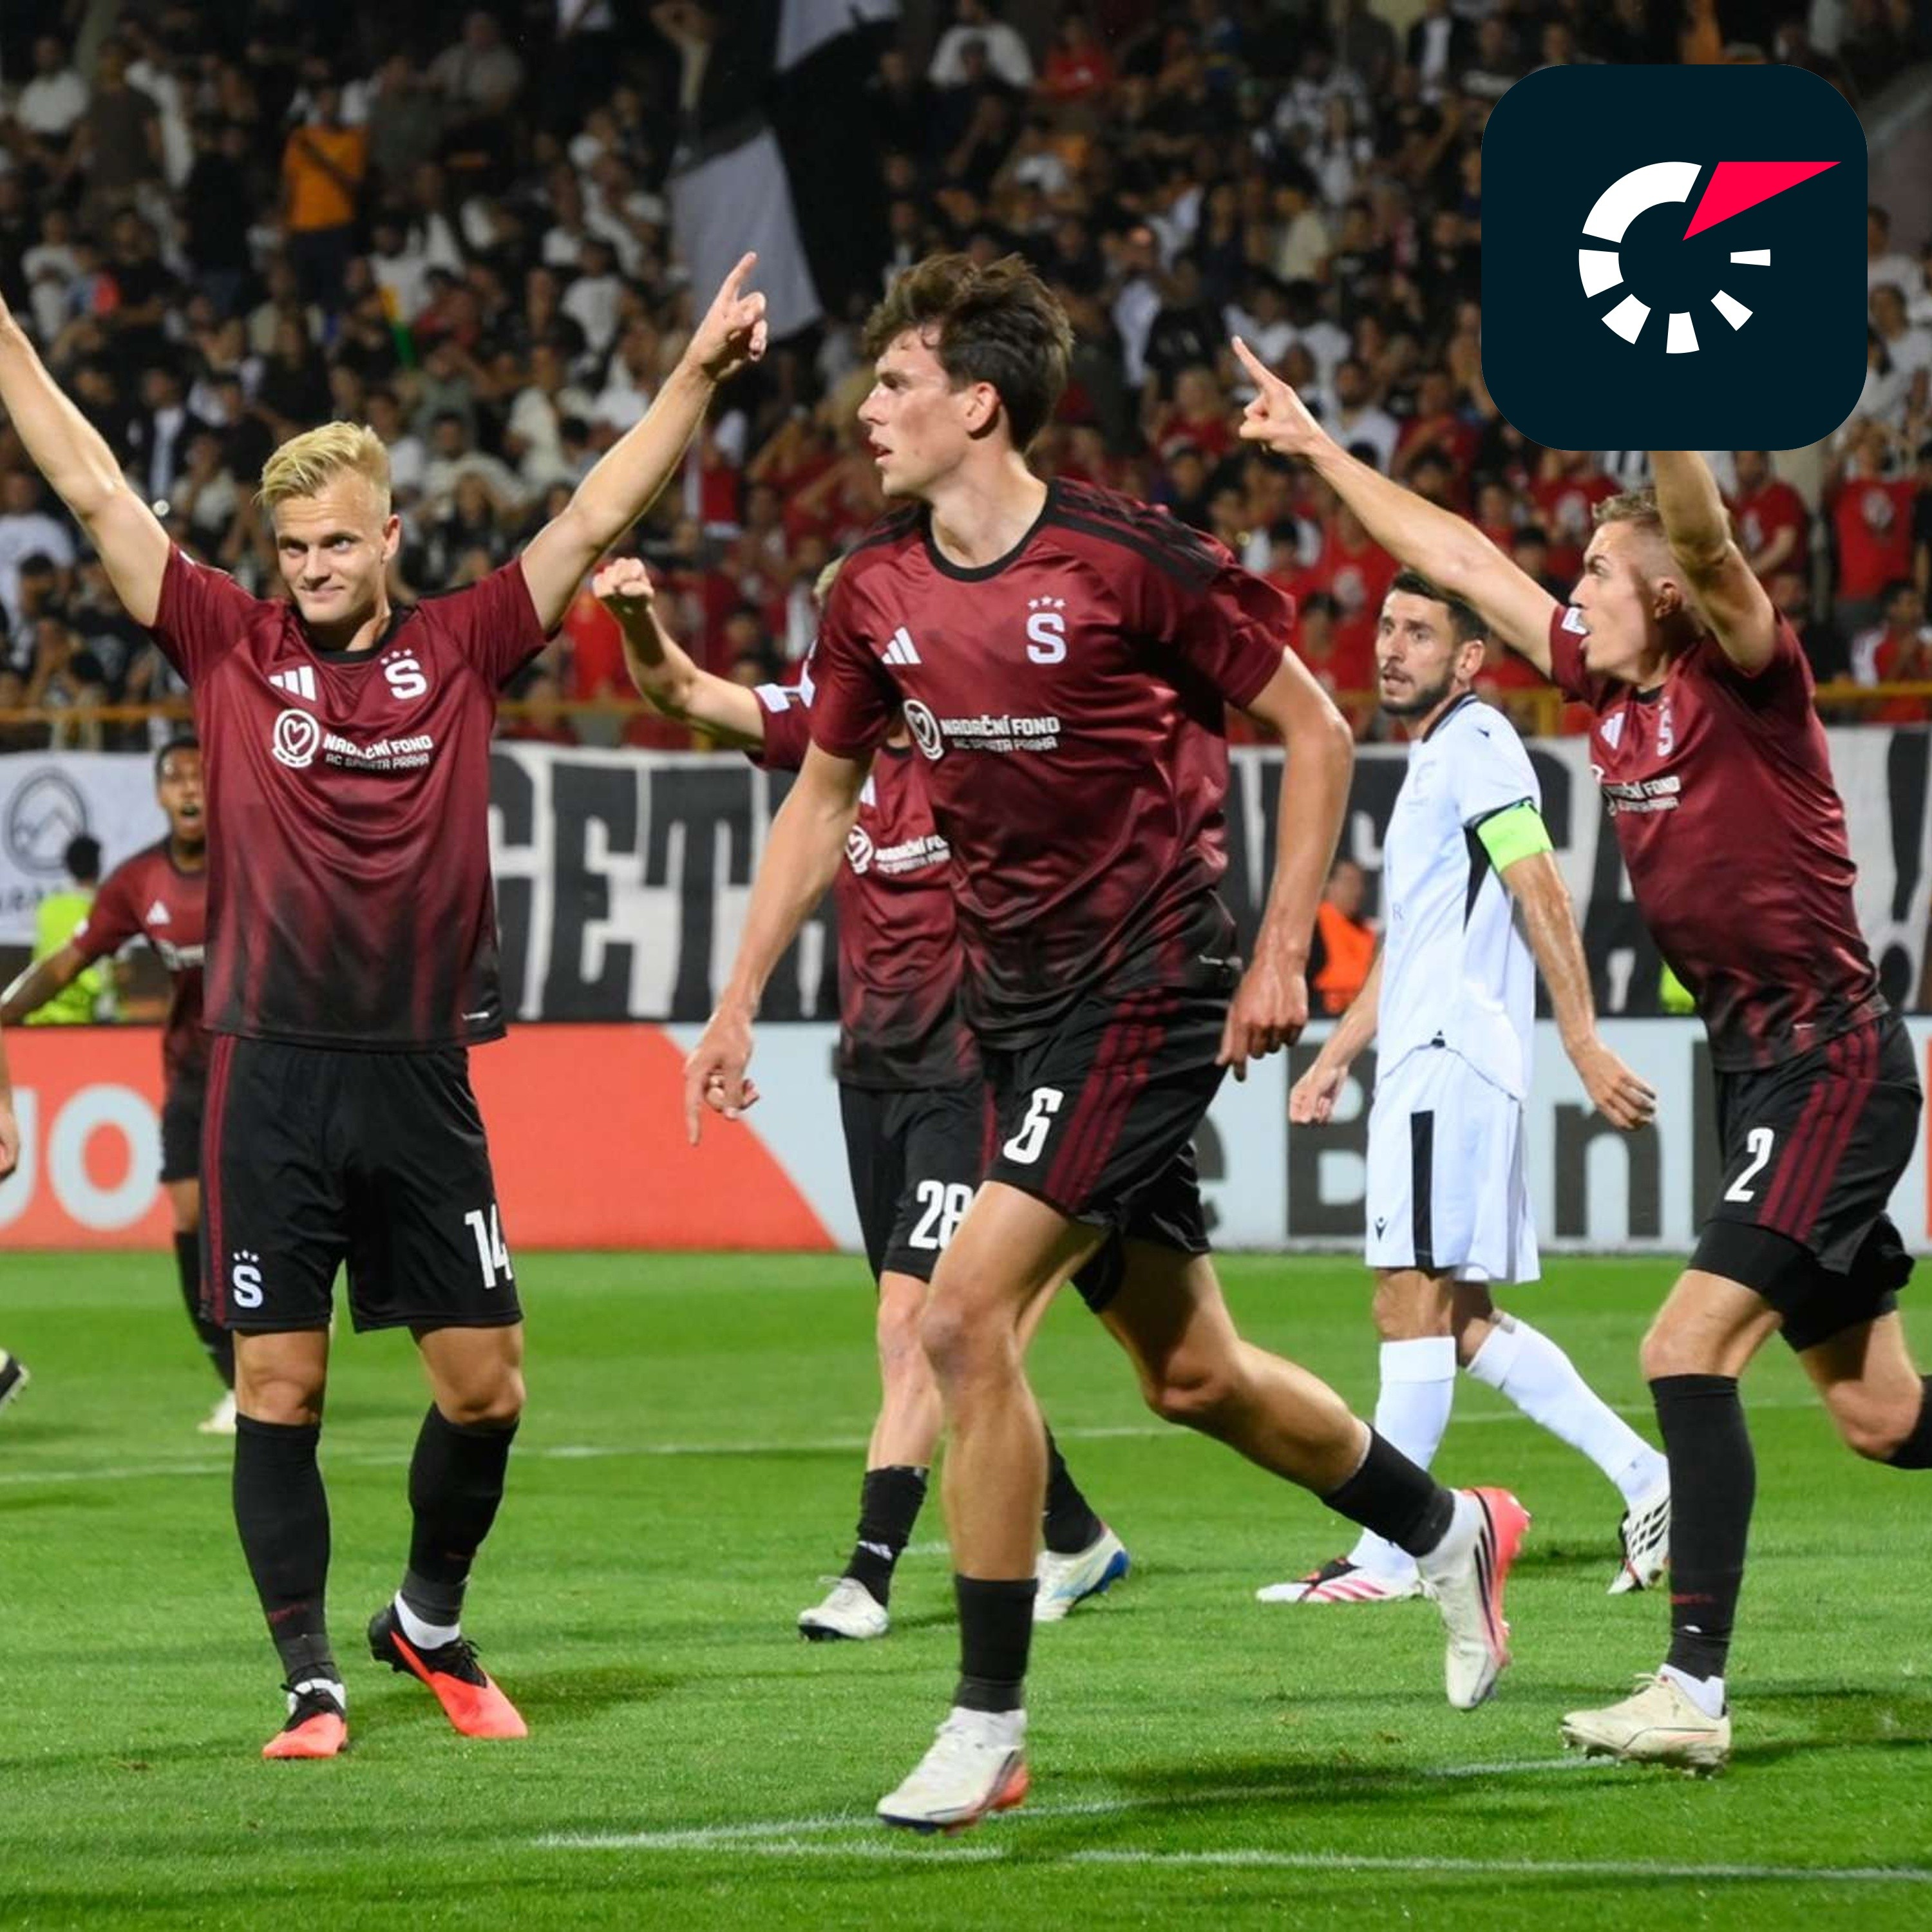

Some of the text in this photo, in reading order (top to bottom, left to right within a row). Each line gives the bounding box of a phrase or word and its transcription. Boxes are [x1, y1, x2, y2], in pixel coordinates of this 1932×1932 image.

[390, 735, 433, 754] FOND
[1011, 717, 1060, 735] FOND
[1003, 1086, 1064, 1164] 6
[1723, 1127, 1775, 1202] 2
[464, 1203, 513, 1289] 14
[908, 1180, 974, 1249] 28
